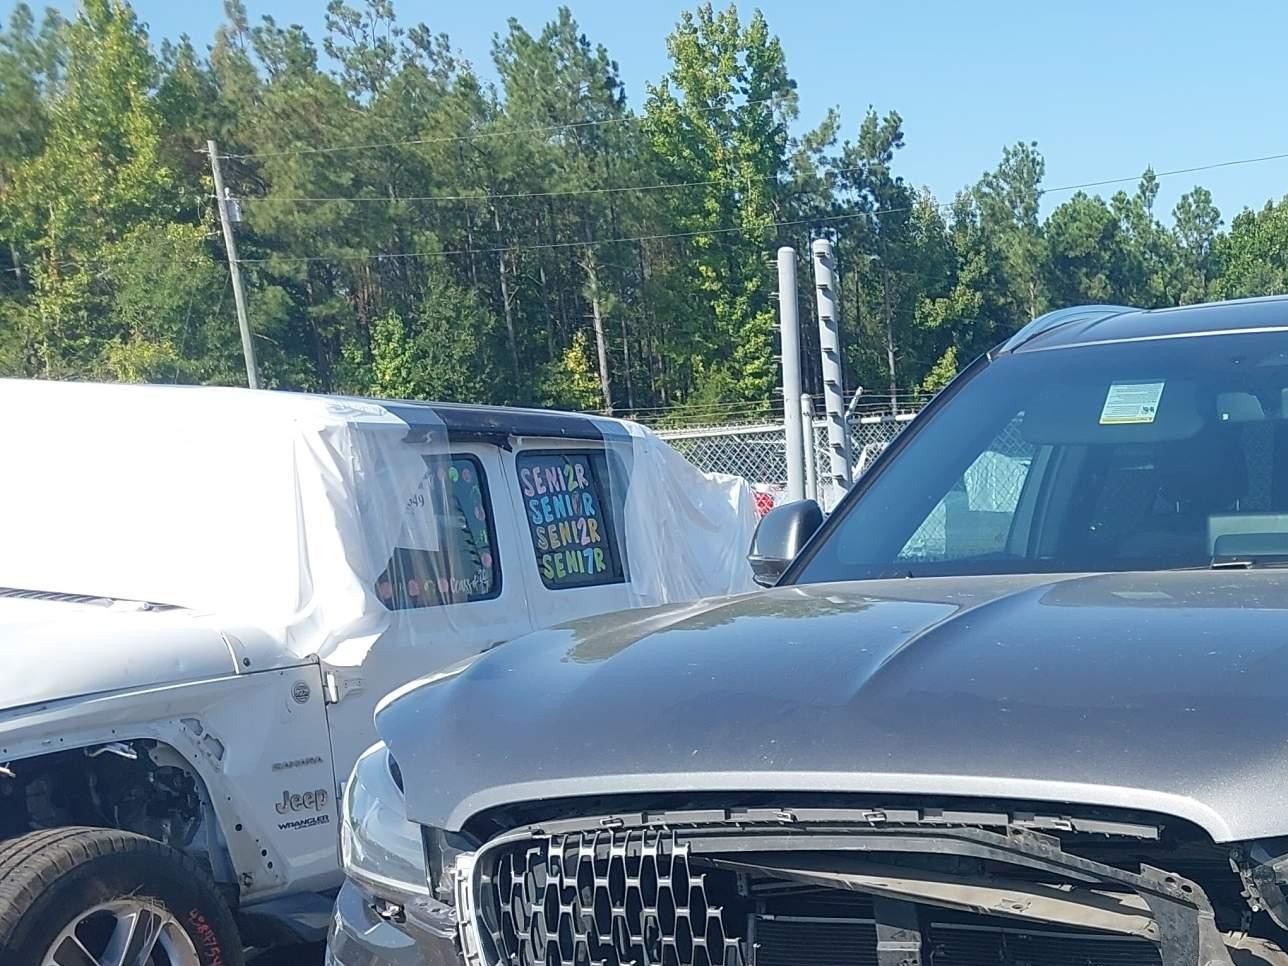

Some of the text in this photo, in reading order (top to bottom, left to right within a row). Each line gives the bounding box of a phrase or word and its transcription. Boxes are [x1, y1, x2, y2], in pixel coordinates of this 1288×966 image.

[520, 463, 589, 497] SENI2R
[536, 517, 601, 550] SENI2R
[275, 789, 328, 815] Jeep
[277, 814, 329, 830] WRANGLER
